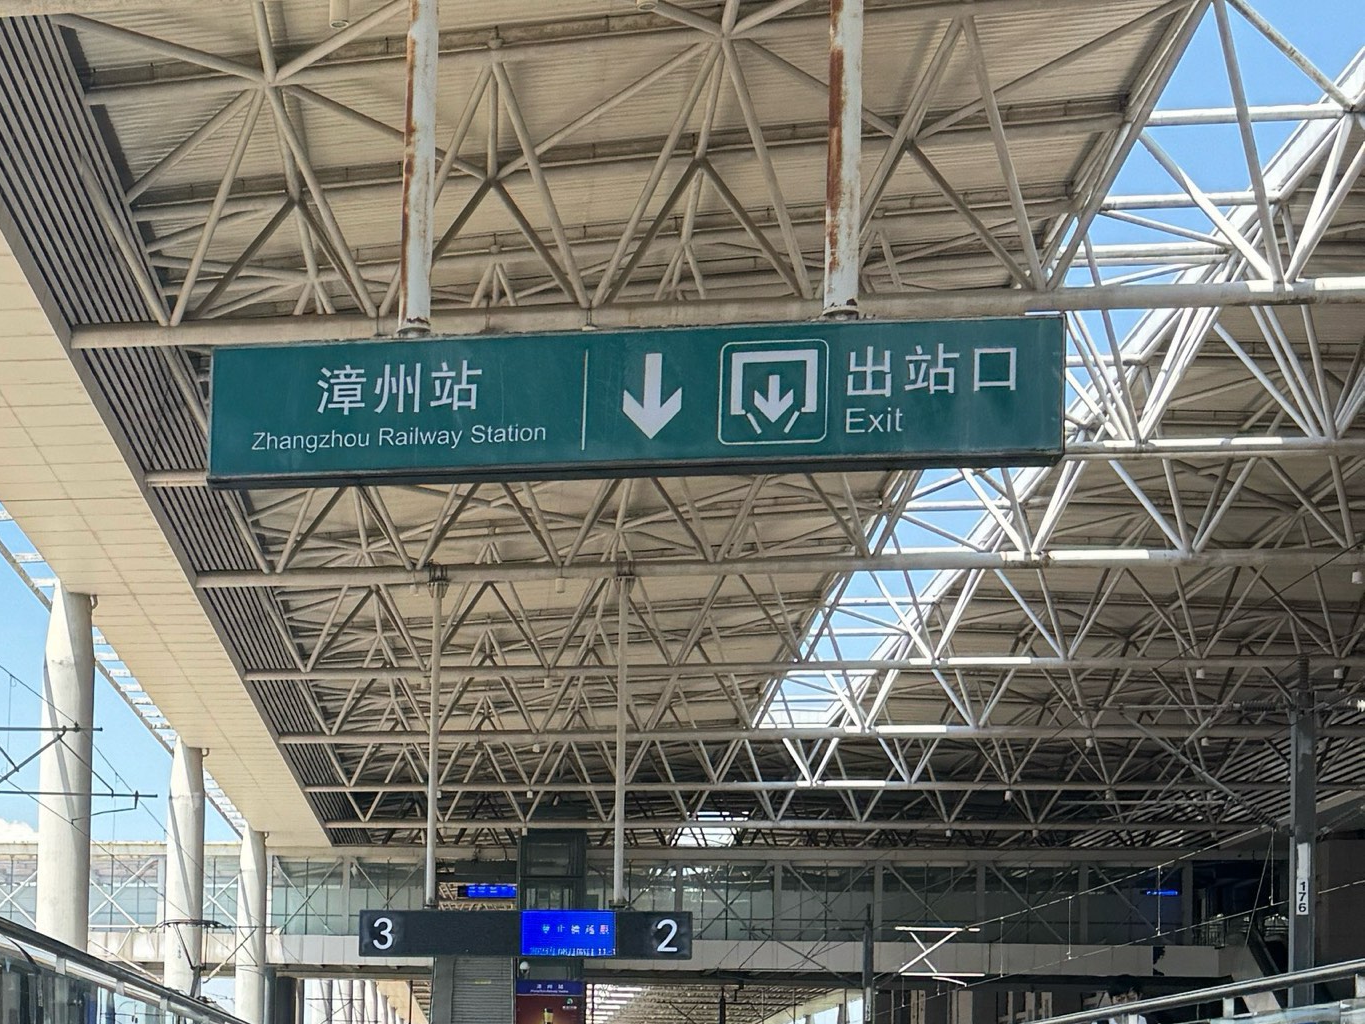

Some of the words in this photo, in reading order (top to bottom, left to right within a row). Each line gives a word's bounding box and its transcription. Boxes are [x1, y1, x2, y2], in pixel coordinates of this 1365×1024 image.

[846, 343, 1017, 399] 出站口
[317, 360, 483, 416] 漳州站
[845, 406, 904, 434] Exit
[251, 429, 370, 453] Zhangzhou
[378, 426, 463, 448] Railway
[471, 423, 547, 445] Station
[1298, 881, 1307, 913] 176
[372, 917, 393, 950] 3
[656, 918, 678, 953] 2
